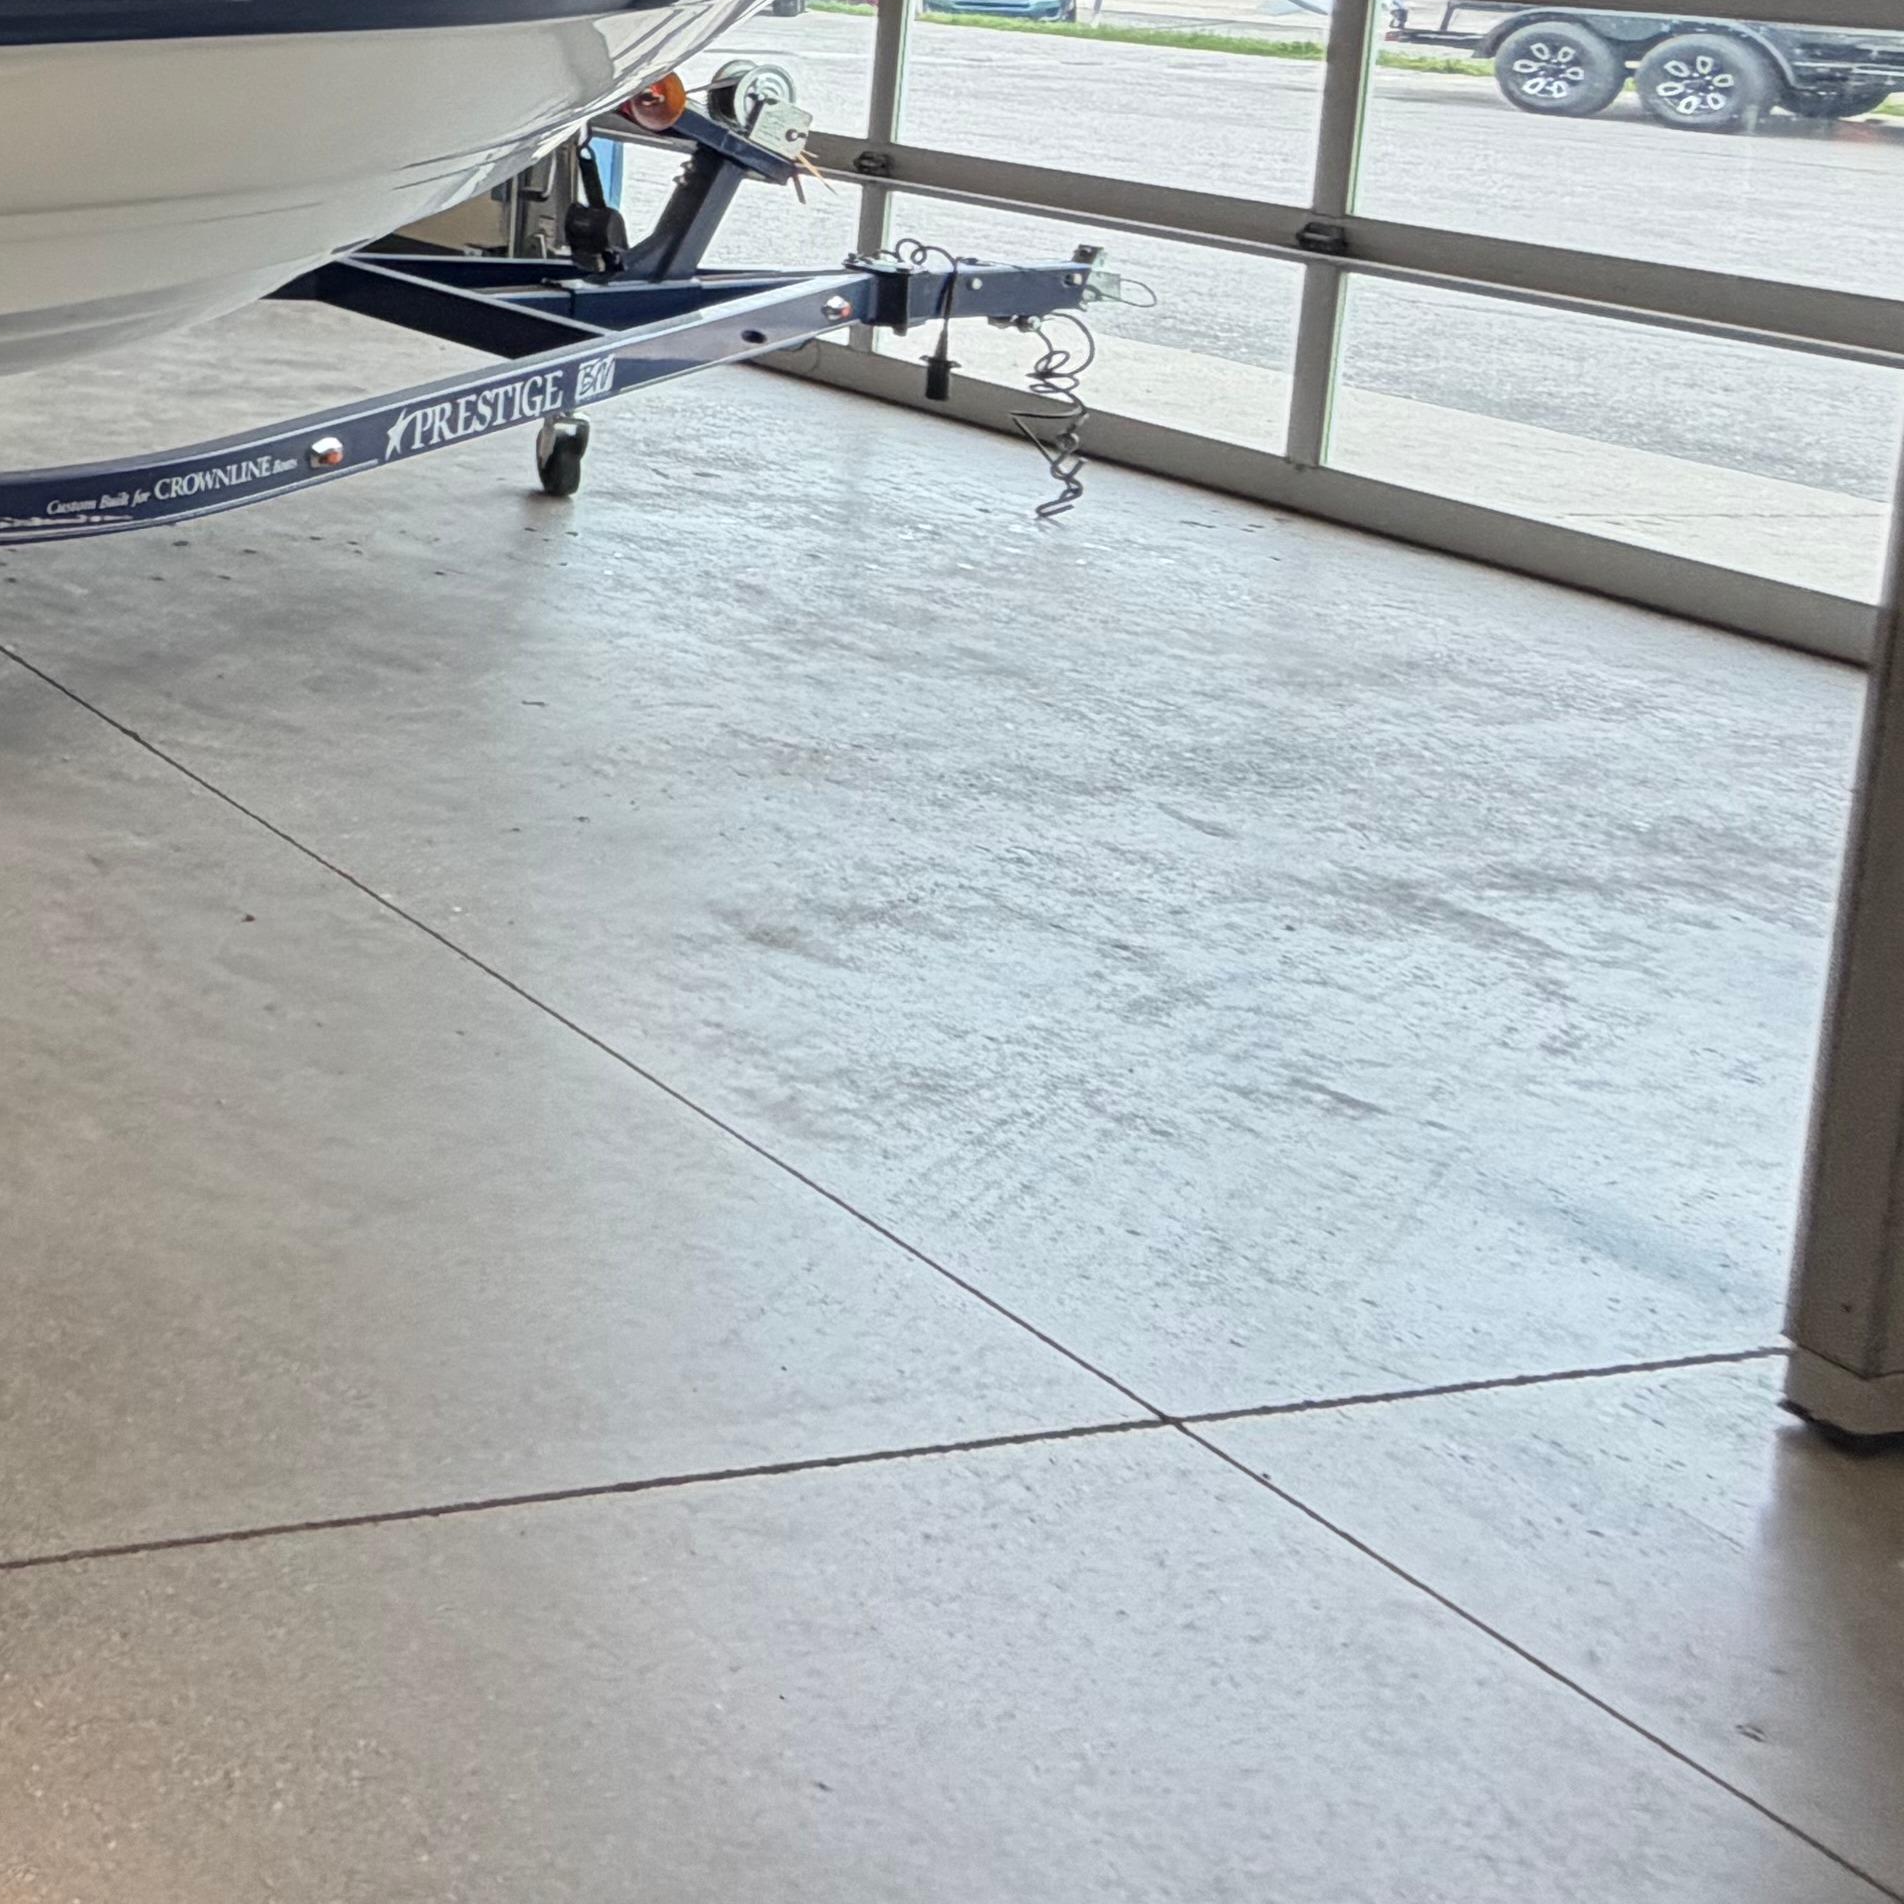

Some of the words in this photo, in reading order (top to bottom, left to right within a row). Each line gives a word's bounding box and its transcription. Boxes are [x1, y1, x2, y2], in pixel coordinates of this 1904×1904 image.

[410, 369, 564, 451] PRESTIGE
[46, 499, 97, 515] Custom
[99, 492, 130, 510] Built
[131, 488, 152, 508] for
[153, 455, 273, 501] CROWNLINE
